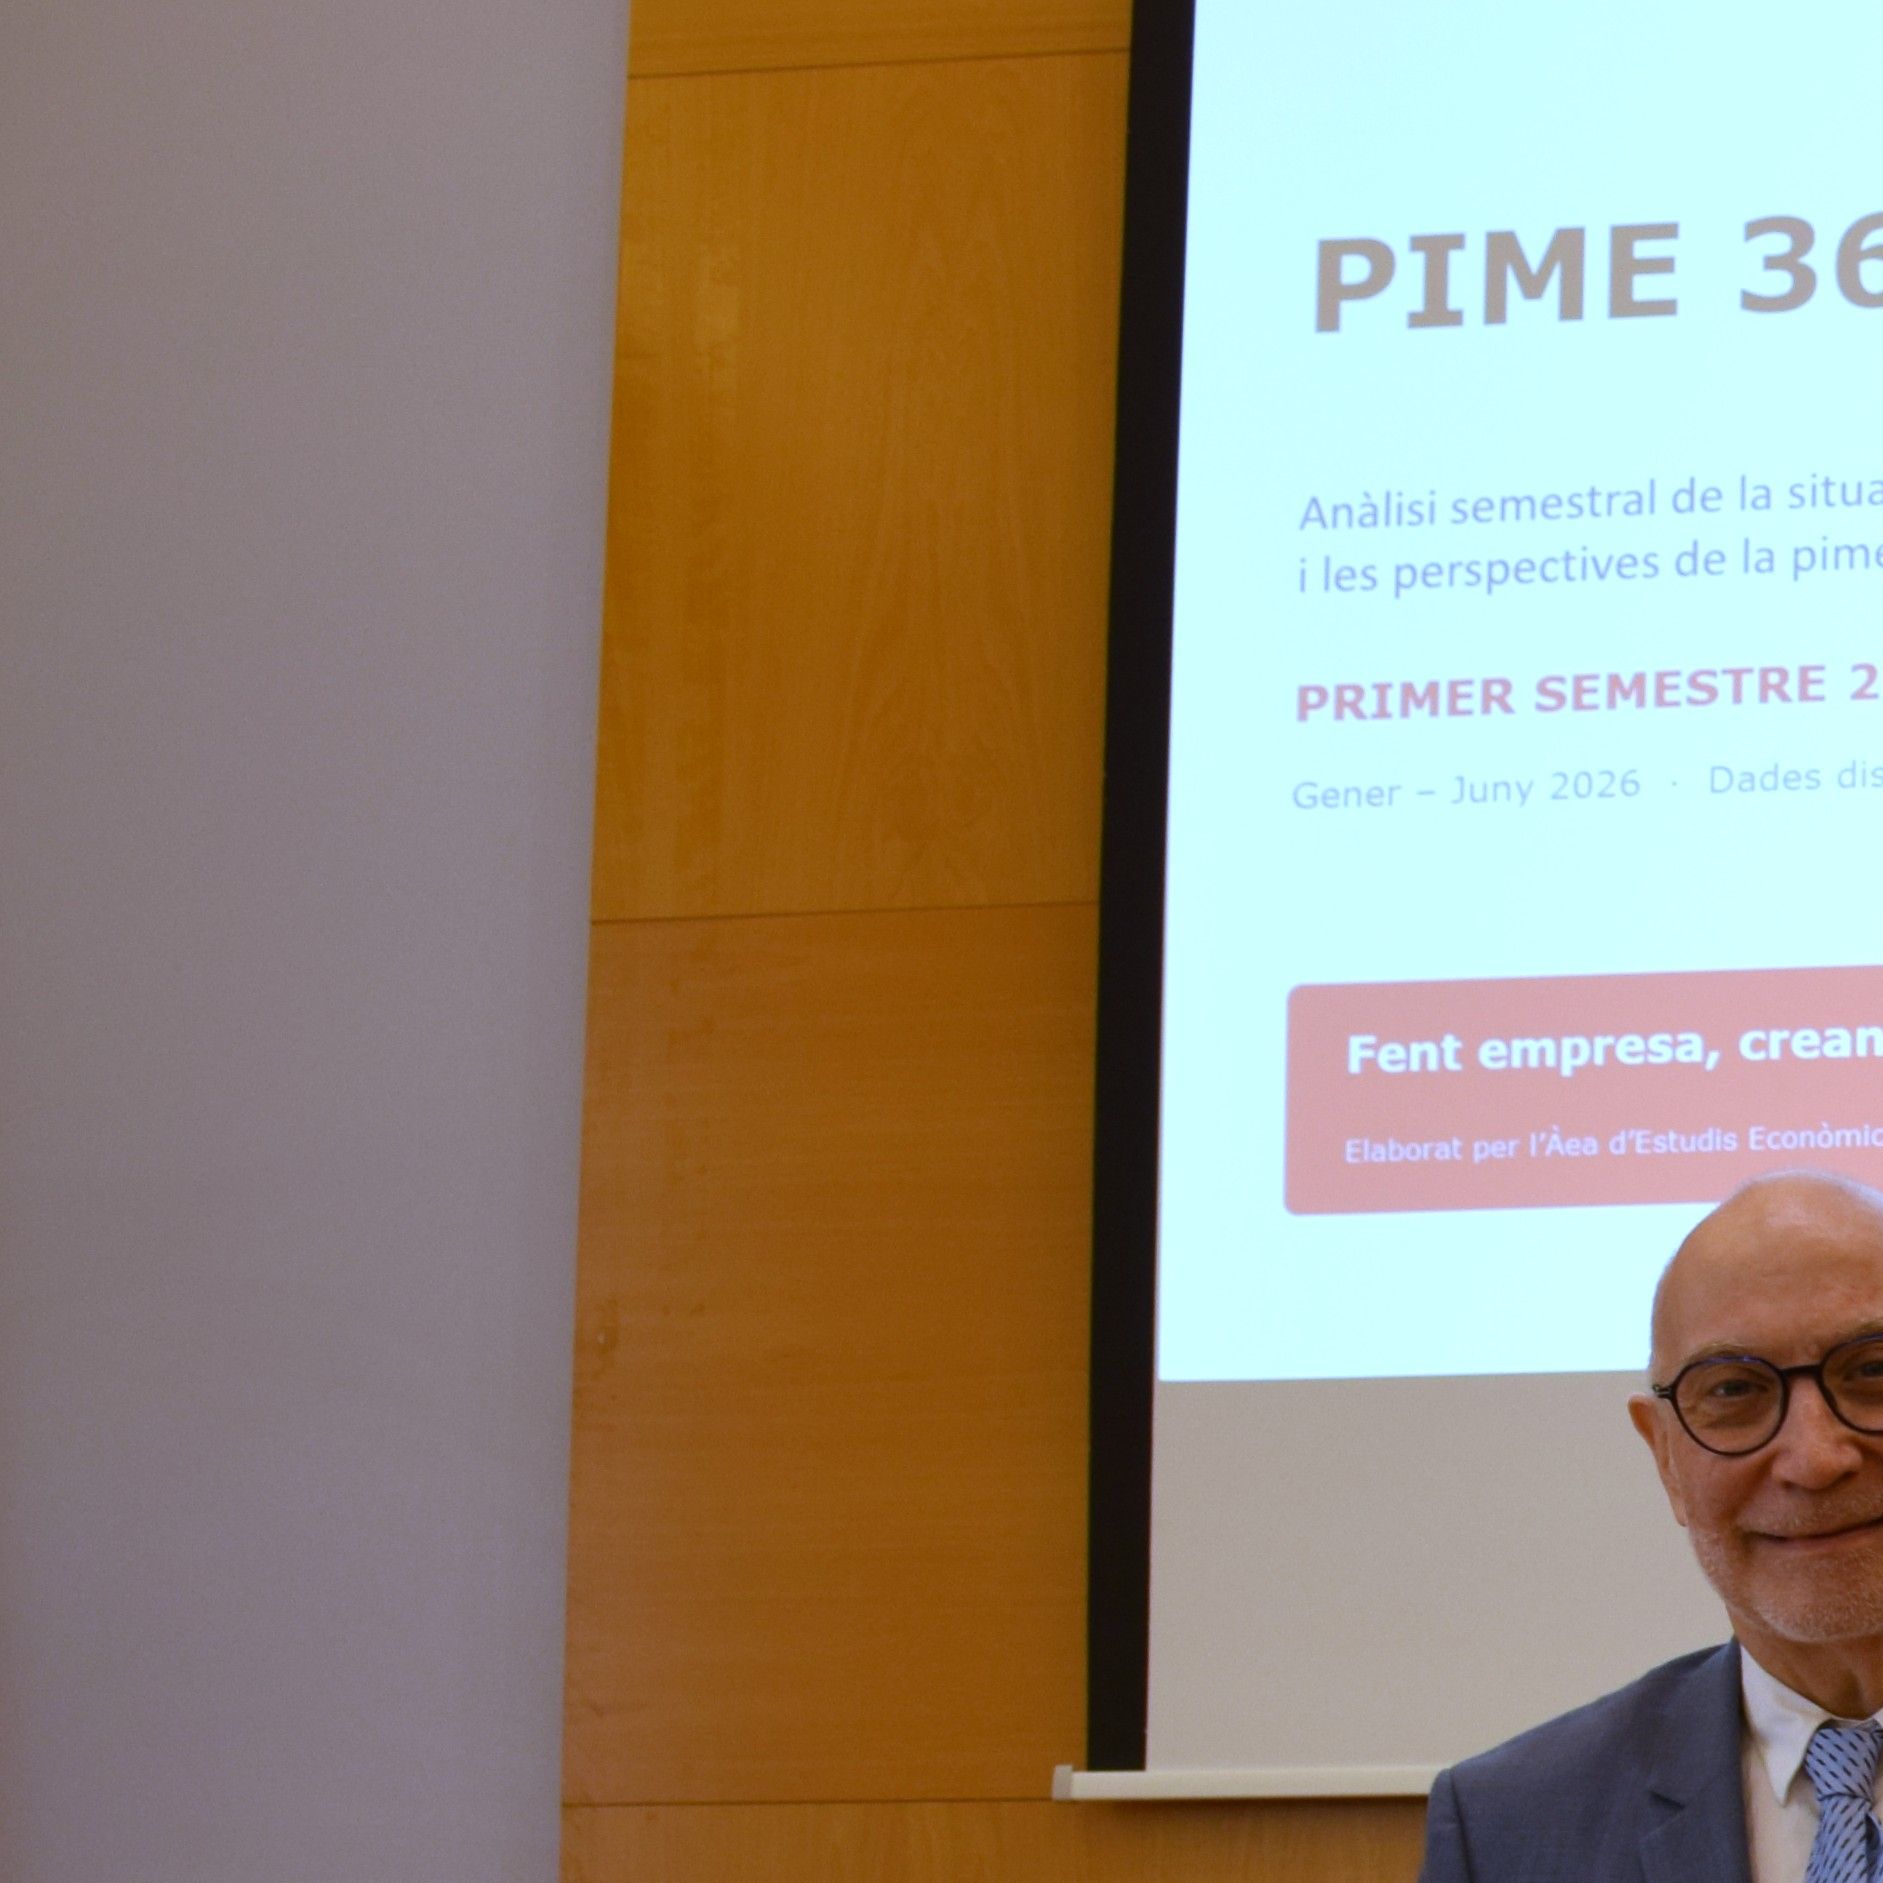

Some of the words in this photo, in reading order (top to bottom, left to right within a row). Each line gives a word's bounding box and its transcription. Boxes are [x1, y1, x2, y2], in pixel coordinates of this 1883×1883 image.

[1316, 222, 1680, 333] PIME
[1299, 490, 1437, 531] Anàlisi
[1451, 478, 1656, 525] semestral
[1672, 476, 1724, 515] de
[1740, 474, 1772, 511] la
[1300, 558, 1307, 593] i
[1324, 555, 1379, 592] les
[1394, 546, 1660, 599] perspectives
[1675, 539, 1727, 577] de
[1744, 537, 1775, 574] la
[1298, 678, 1516, 722] PRIMER
[1535, 665, 1827, 713] SEMESTRE
[1292, 781, 1403, 810] Gener
[1451, 775, 1534, 808] Juny
[1550, 768, 1641, 801] 2026
[1710, 762, 1822, 795] Dades
[1348, 1032, 1464, 1074] Fent
[1477, 1031, 1722, 1078] empresa,
[1344, 1136, 1464, 1164] Elaborat
[1472, 1139, 1521, 1164] per
